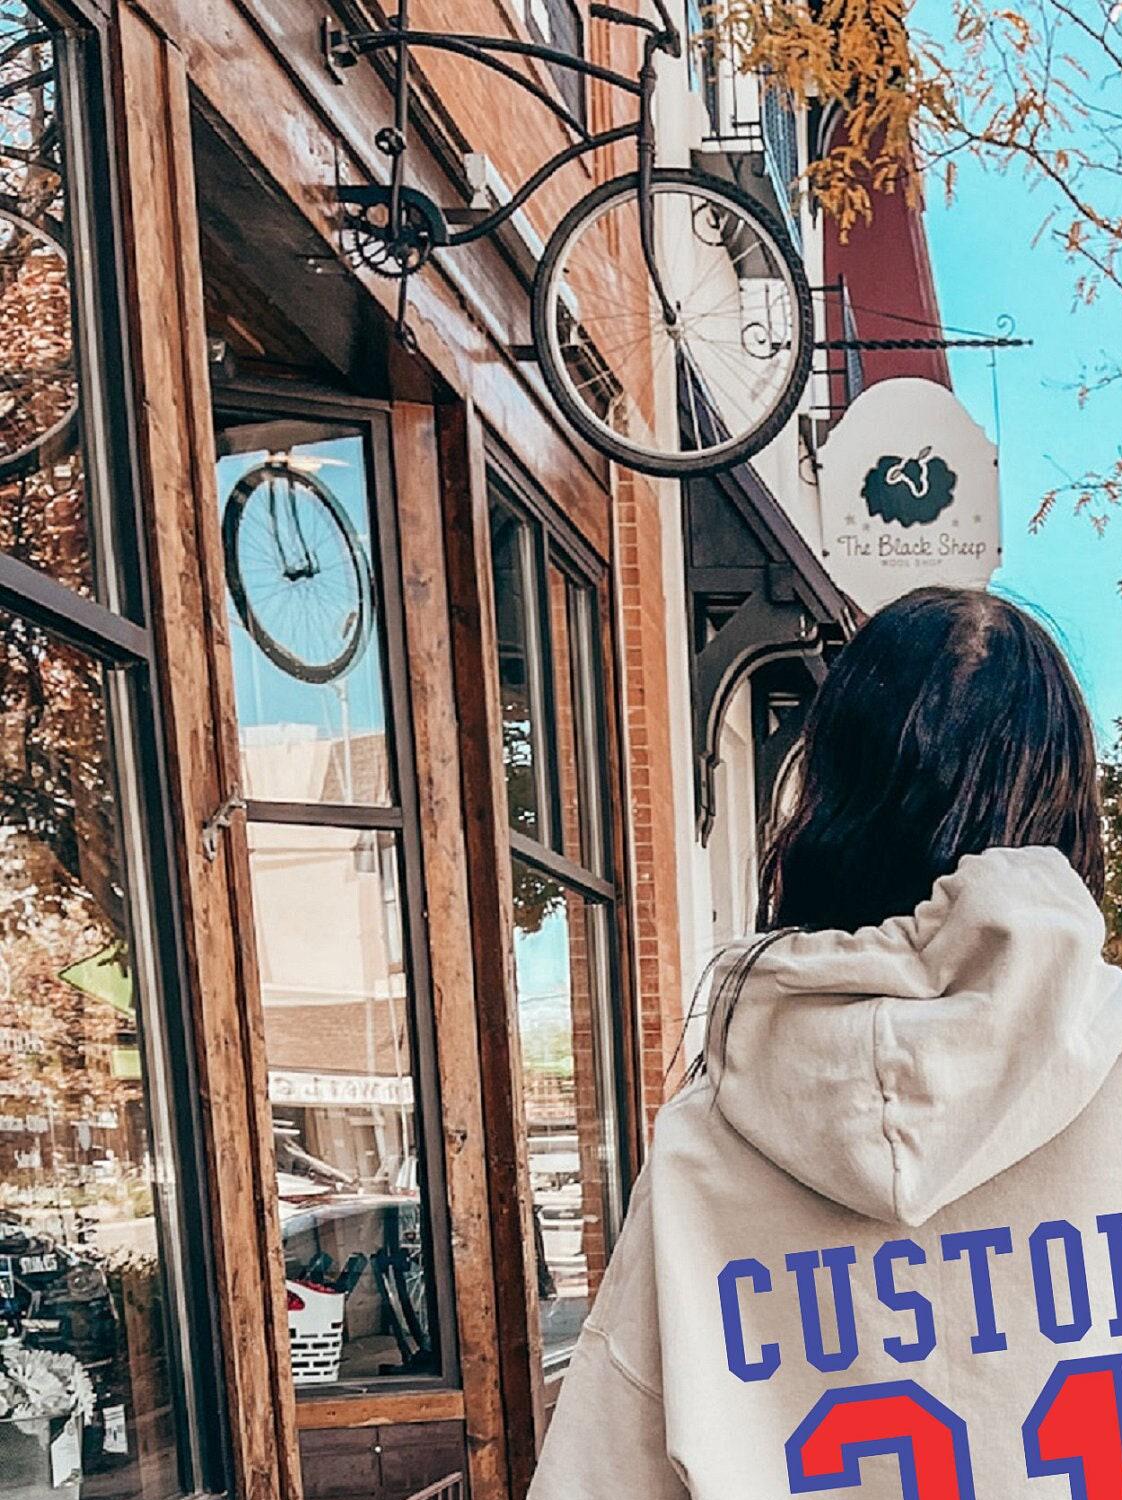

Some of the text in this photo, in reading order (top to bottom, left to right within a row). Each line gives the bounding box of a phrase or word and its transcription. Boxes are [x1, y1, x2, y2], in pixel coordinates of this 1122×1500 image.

[837, 532, 987, 560] The Black Sheep
